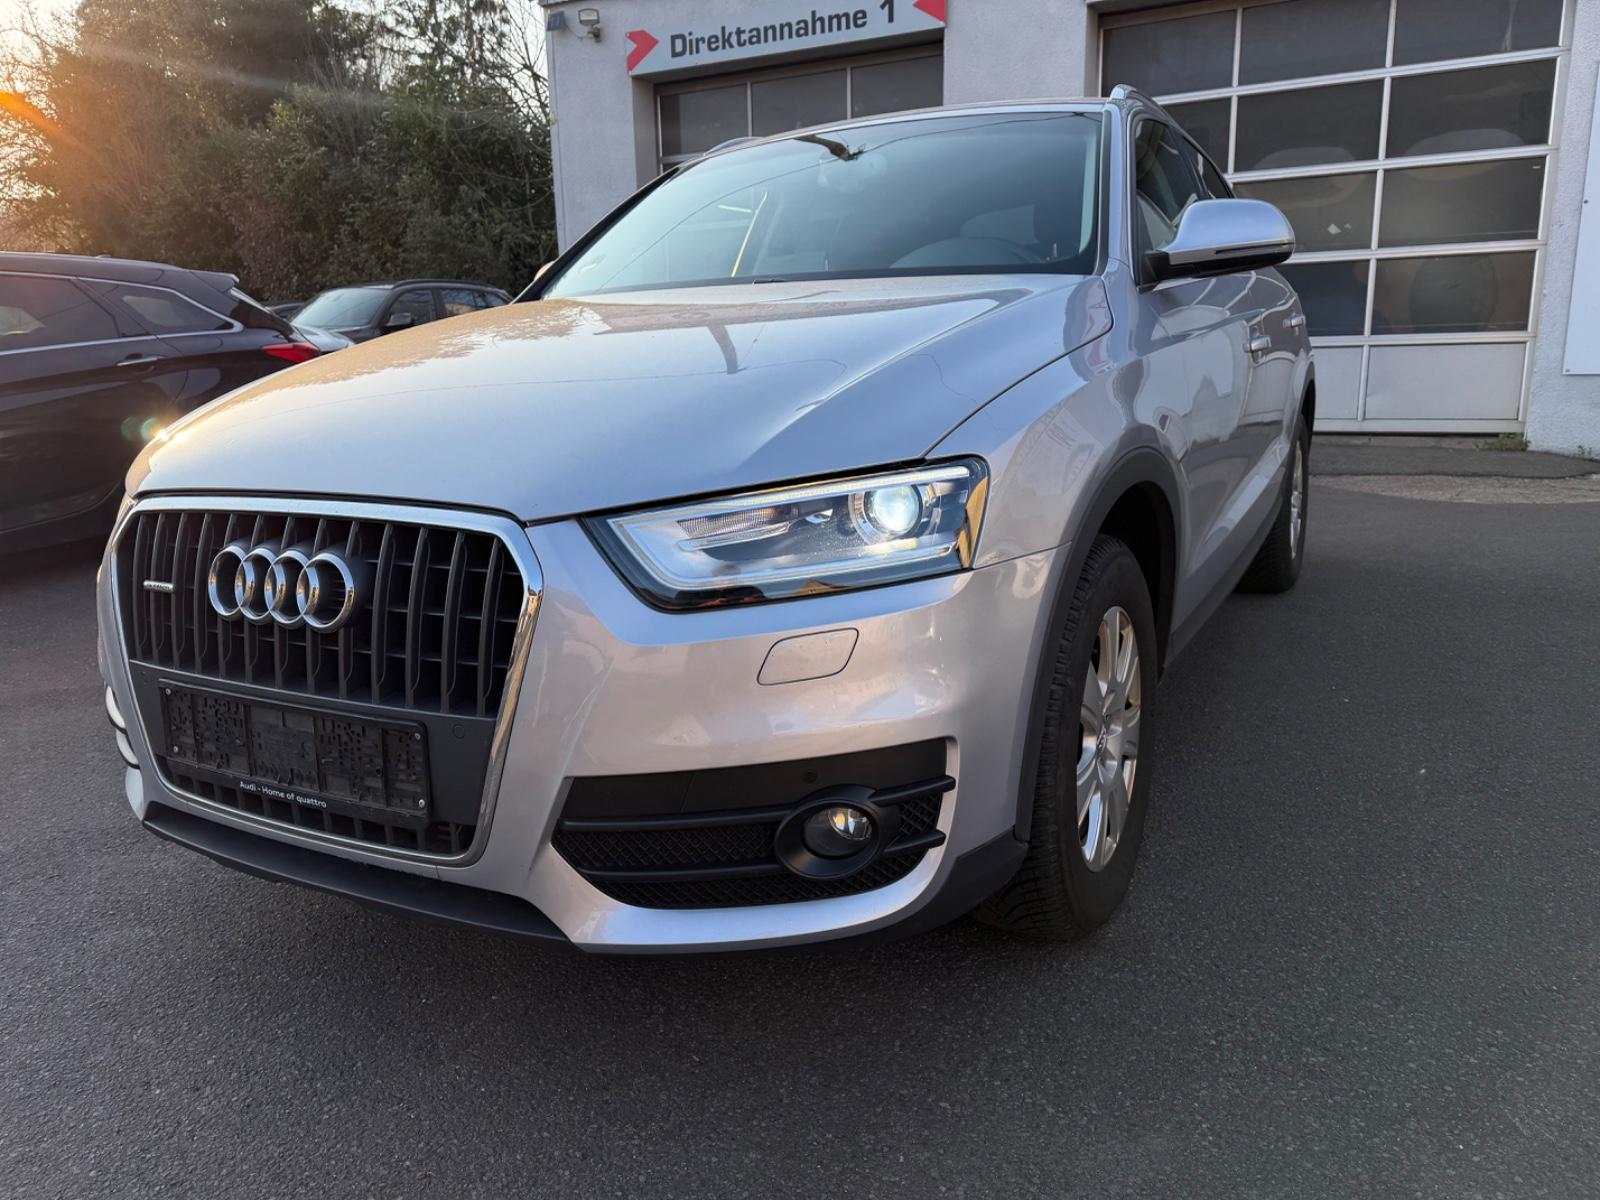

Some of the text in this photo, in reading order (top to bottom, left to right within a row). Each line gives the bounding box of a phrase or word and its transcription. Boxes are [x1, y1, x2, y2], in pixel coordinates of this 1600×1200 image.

[670, 0, 894, 58] Direktannahme 1
[240, 781, 256, 791] Audi
[262, 786, 285, 798] Home
[296, 795, 327, 808] quattro
